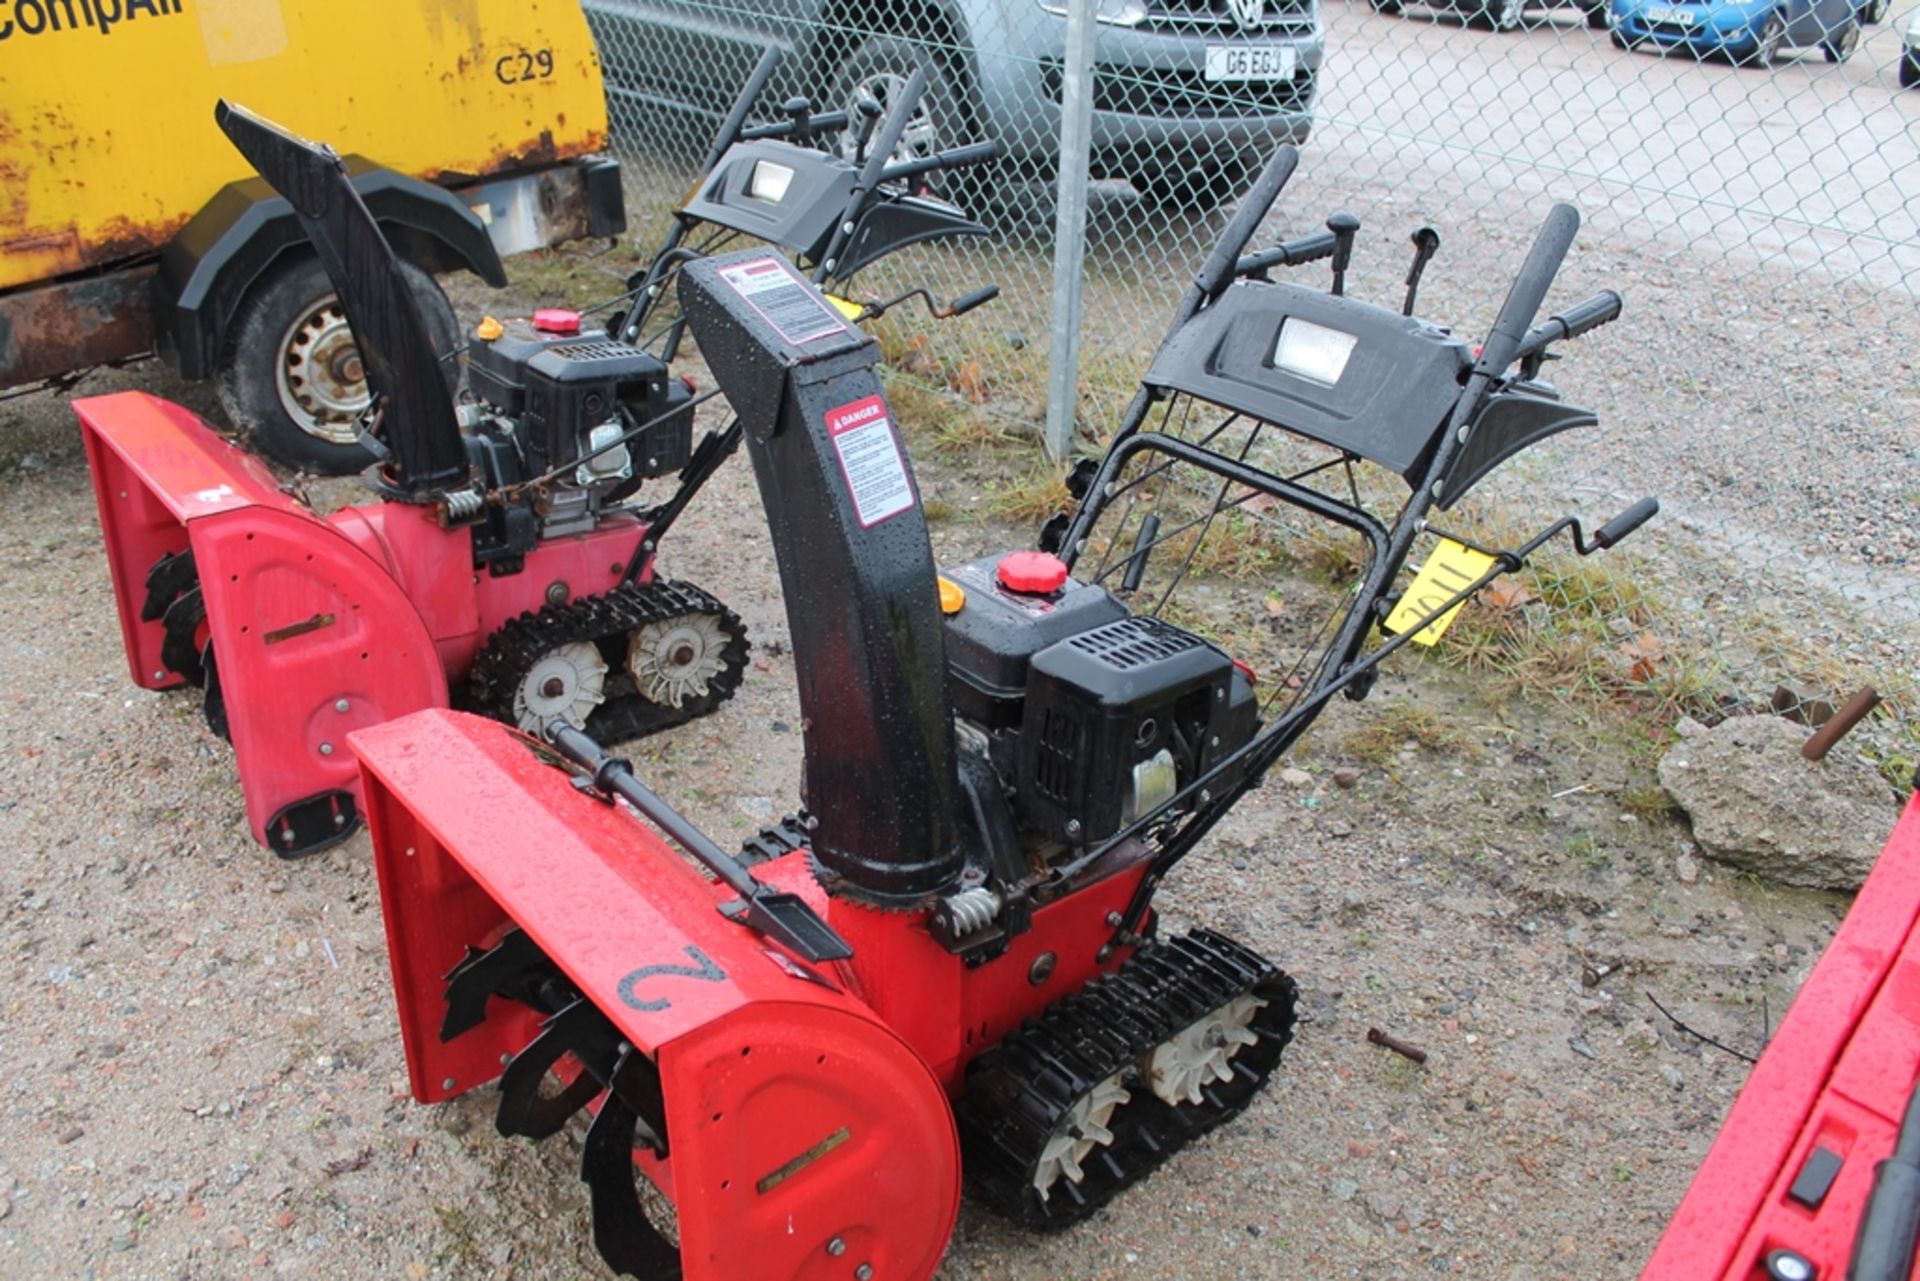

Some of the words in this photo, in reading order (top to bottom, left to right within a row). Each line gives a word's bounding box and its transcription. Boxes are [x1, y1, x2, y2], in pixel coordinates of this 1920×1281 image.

[0, 0, 183, 40] ompA
[495, 49, 553, 85] C29
[840, 404, 880, 426] DANGER
[617, 944, 727, 1013] 2
